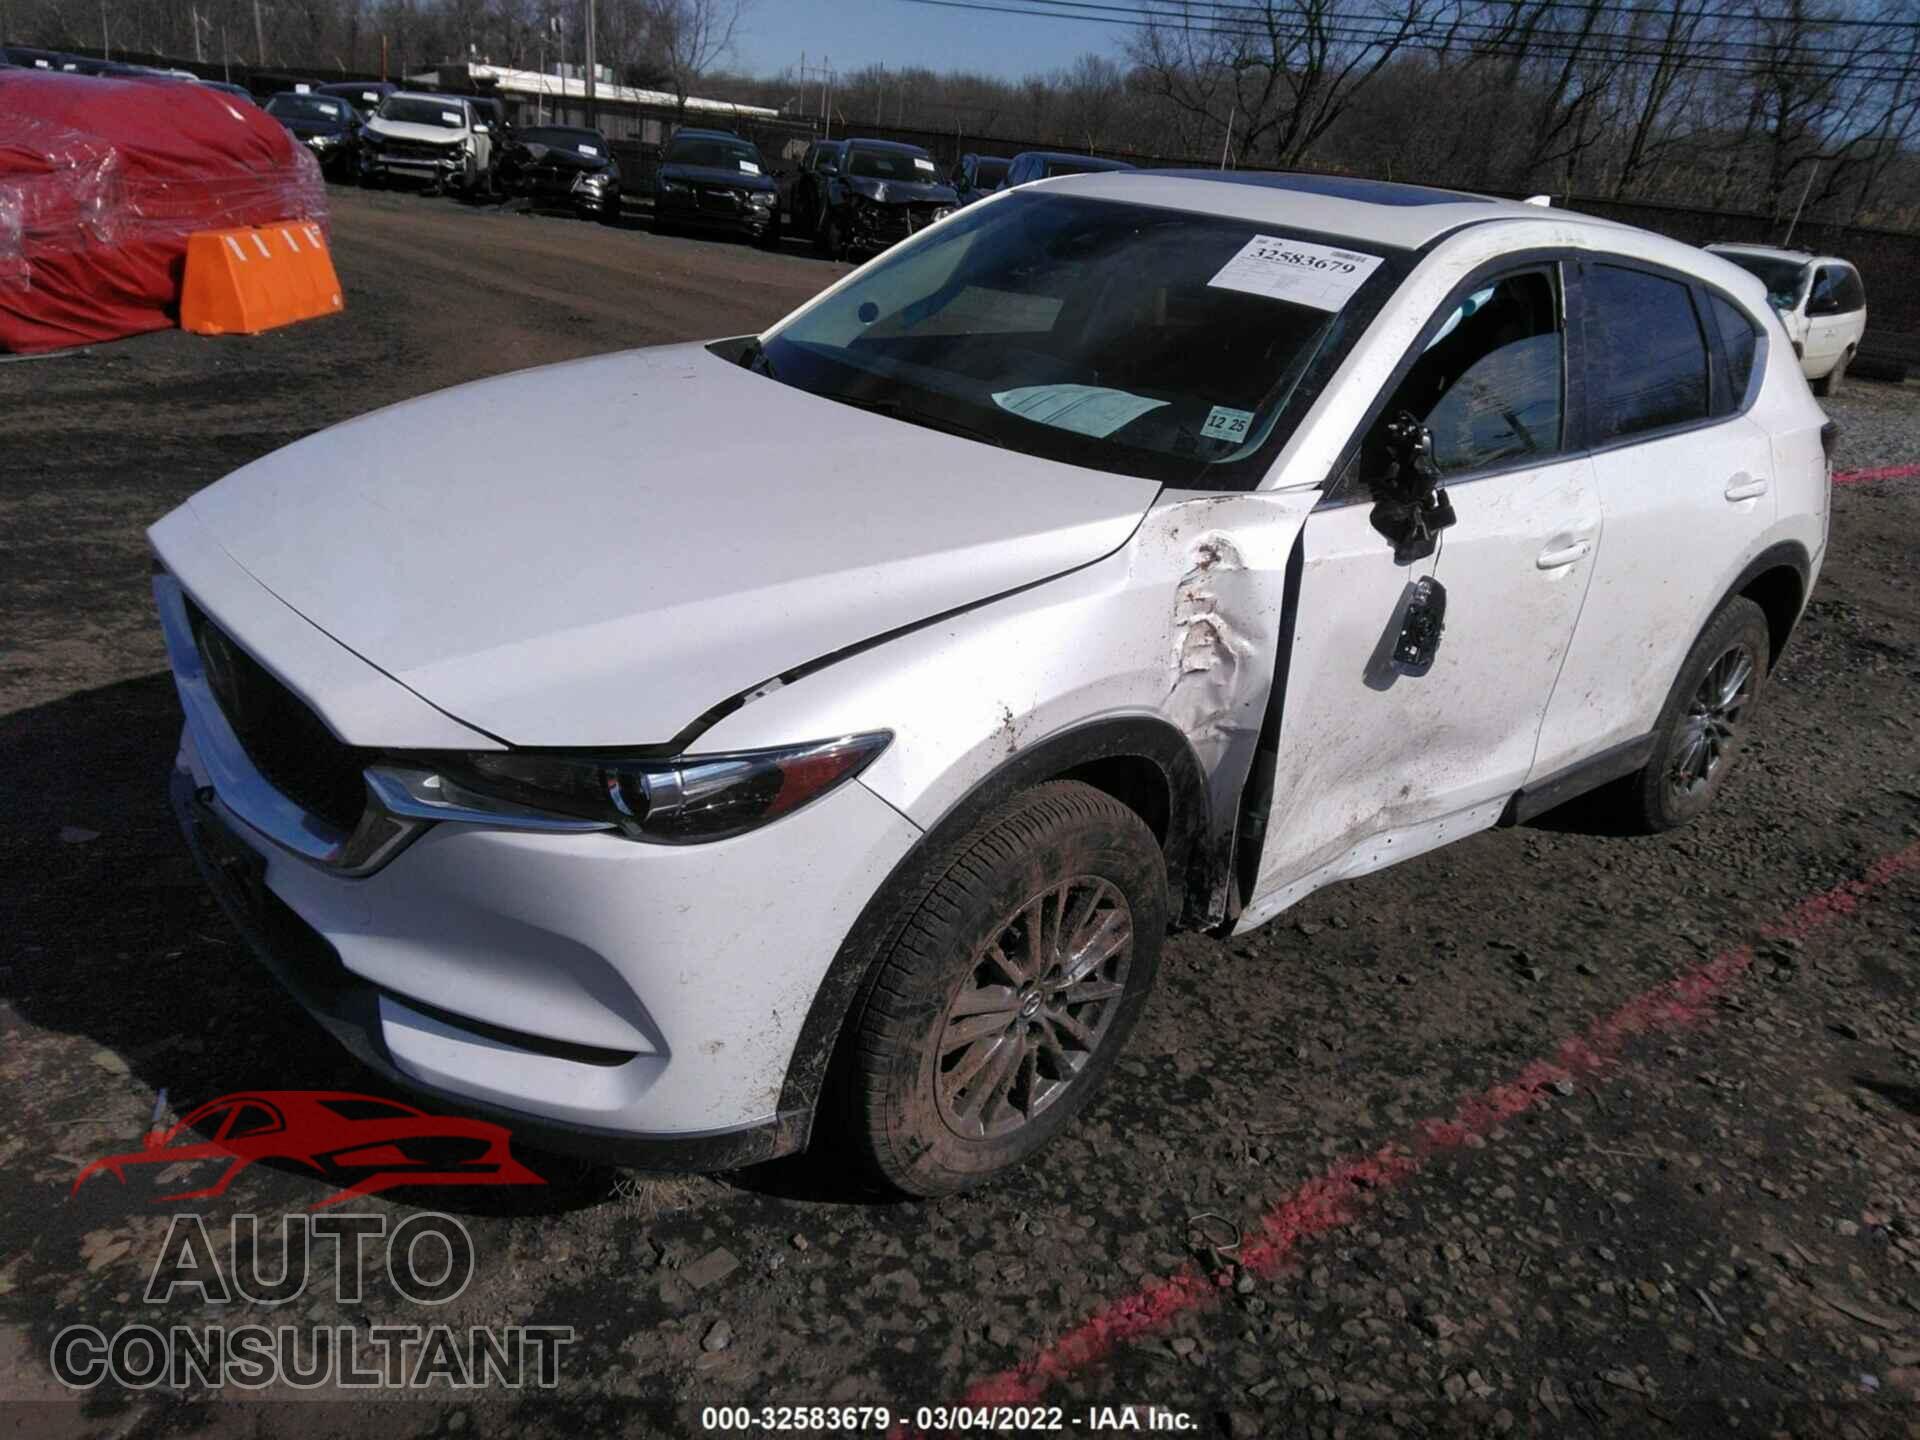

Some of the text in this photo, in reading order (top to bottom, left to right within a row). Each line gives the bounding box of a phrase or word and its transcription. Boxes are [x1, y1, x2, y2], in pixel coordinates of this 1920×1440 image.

[1251, 247, 1356, 274] 32583679
[1208, 415, 1247, 432] 12 25
